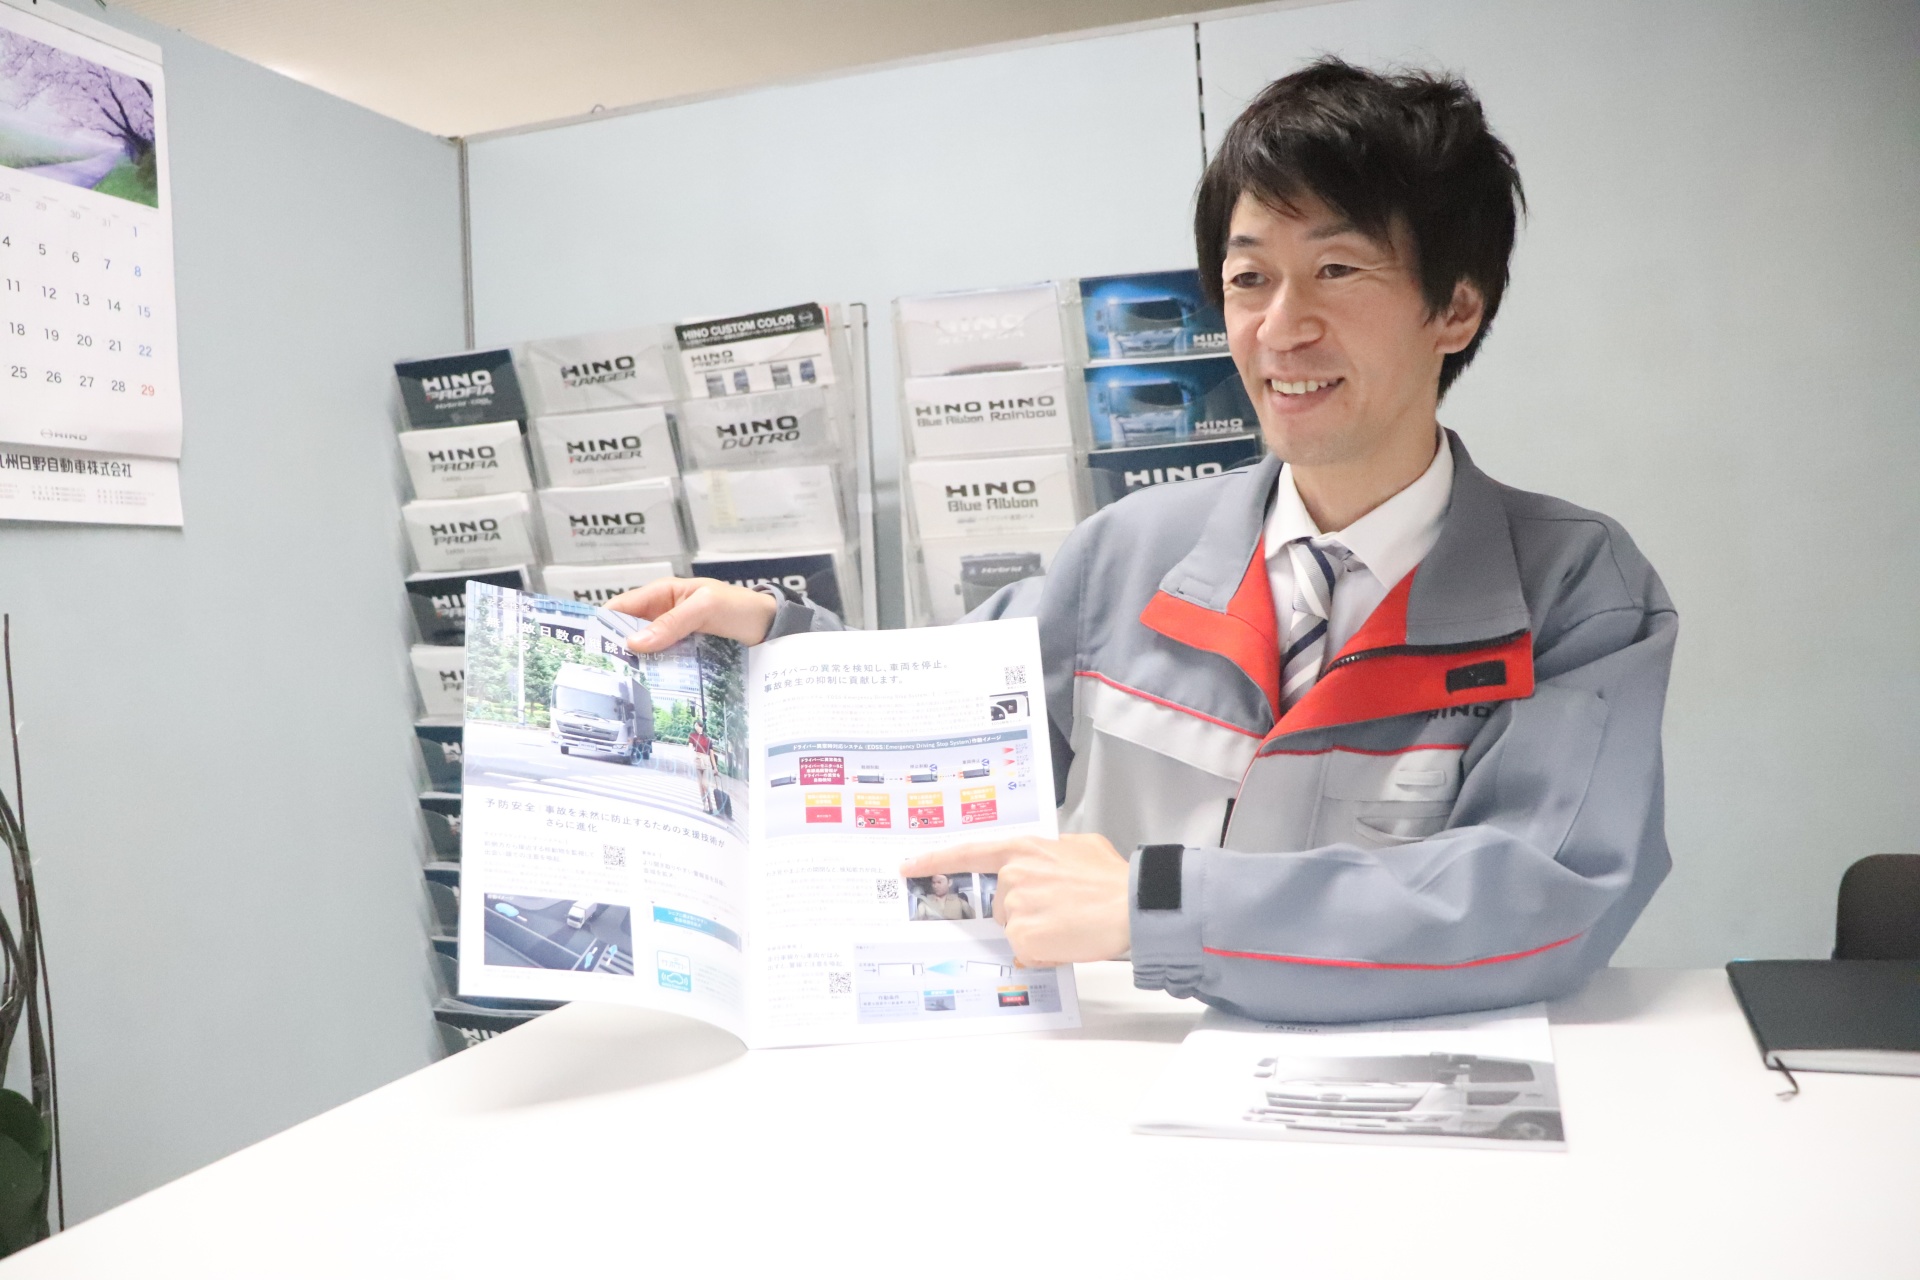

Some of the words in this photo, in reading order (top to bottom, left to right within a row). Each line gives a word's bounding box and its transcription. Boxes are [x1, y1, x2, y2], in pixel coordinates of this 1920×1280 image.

[35, 200, 47, 211] 29
[70, 209, 81, 220] 30
[102, 218, 111, 228] 31
[133, 226, 138, 238] 1
[2, 236, 11, 247] 4
[38, 243, 47, 255] 5
[71, 251, 80, 263] 6
[104, 258, 111, 270] 7
[134, 265, 142, 278] 8
[6, 278, 20, 292] 11
[42, 286, 57, 300] 12
[75, 293, 90, 306] 13
[108, 299, 121, 312] 14
[138, 305, 151, 318] 15
[682, 326, 709, 341] HINO
[710, 320, 756, 336] CUSTOM
[756, 313, 796, 329] COLOR
[9, 322, 26, 336] 18
[45, 328, 60, 341] 19
[77, 334, 93, 347] 20
[109, 340, 122, 353] 21
[139, 345, 153, 358] 22
[691, 349, 733, 363] HINO
[560, 355, 636, 379] HINO
[11, 366, 28, 380] 25
[46, 371, 62, 384] 26
[79, 376, 94, 388] 27
[111, 381, 126, 393] 28
[141, 385, 155, 397] 29
[422, 370, 492, 391] HINO
[564, 369, 636, 388] RANGER
[426, 385, 494, 403] PROFIA
[915, 401, 981, 417] HINO
[988, 395, 1055, 410] HINO
[717, 415, 799, 438] HINO
[917, 417, 942, 427] Blue
[945, 413, 984, 426] Ribbon
[990, 408, 1057, 422] Rainbow
[1195, 418, 1243, 430] HINO
[53, 432, 88, 441] HINO
[566, 435, 641, 454] HINO
[721, 430, 800, 451] DUTRO
[428, 445, 496, 462] HINO
[569, 449, 642, 464] RANGER
[431, 459, 499, 473] PROFIA
[1124, 462, 1222, 487] HINO
[945, 480, 1036, 498] HINO
[948, 499, 982, 513] Blue
[986, 497, 1039, 511] Ribbon
[430, 518, 498, 536] HINO
[569, 512, 645, 529] HINO
[434, 531, 502, 546] PROFIA
[572, 525, 646, 537] RANGER
[573, 585, 642, 602] HIN
[764, 660, 948, 682] ドライバーの異常を検知し、車両を停止。
[764, 674, 903, 694] 事故発生の抑制に貢献します。
[485, 797, 536, 814] 予防安全
[545, 804, 726, 849] 事故を未然に防止するための支援技術が
[545, 817, 598, 833] さらに進化
